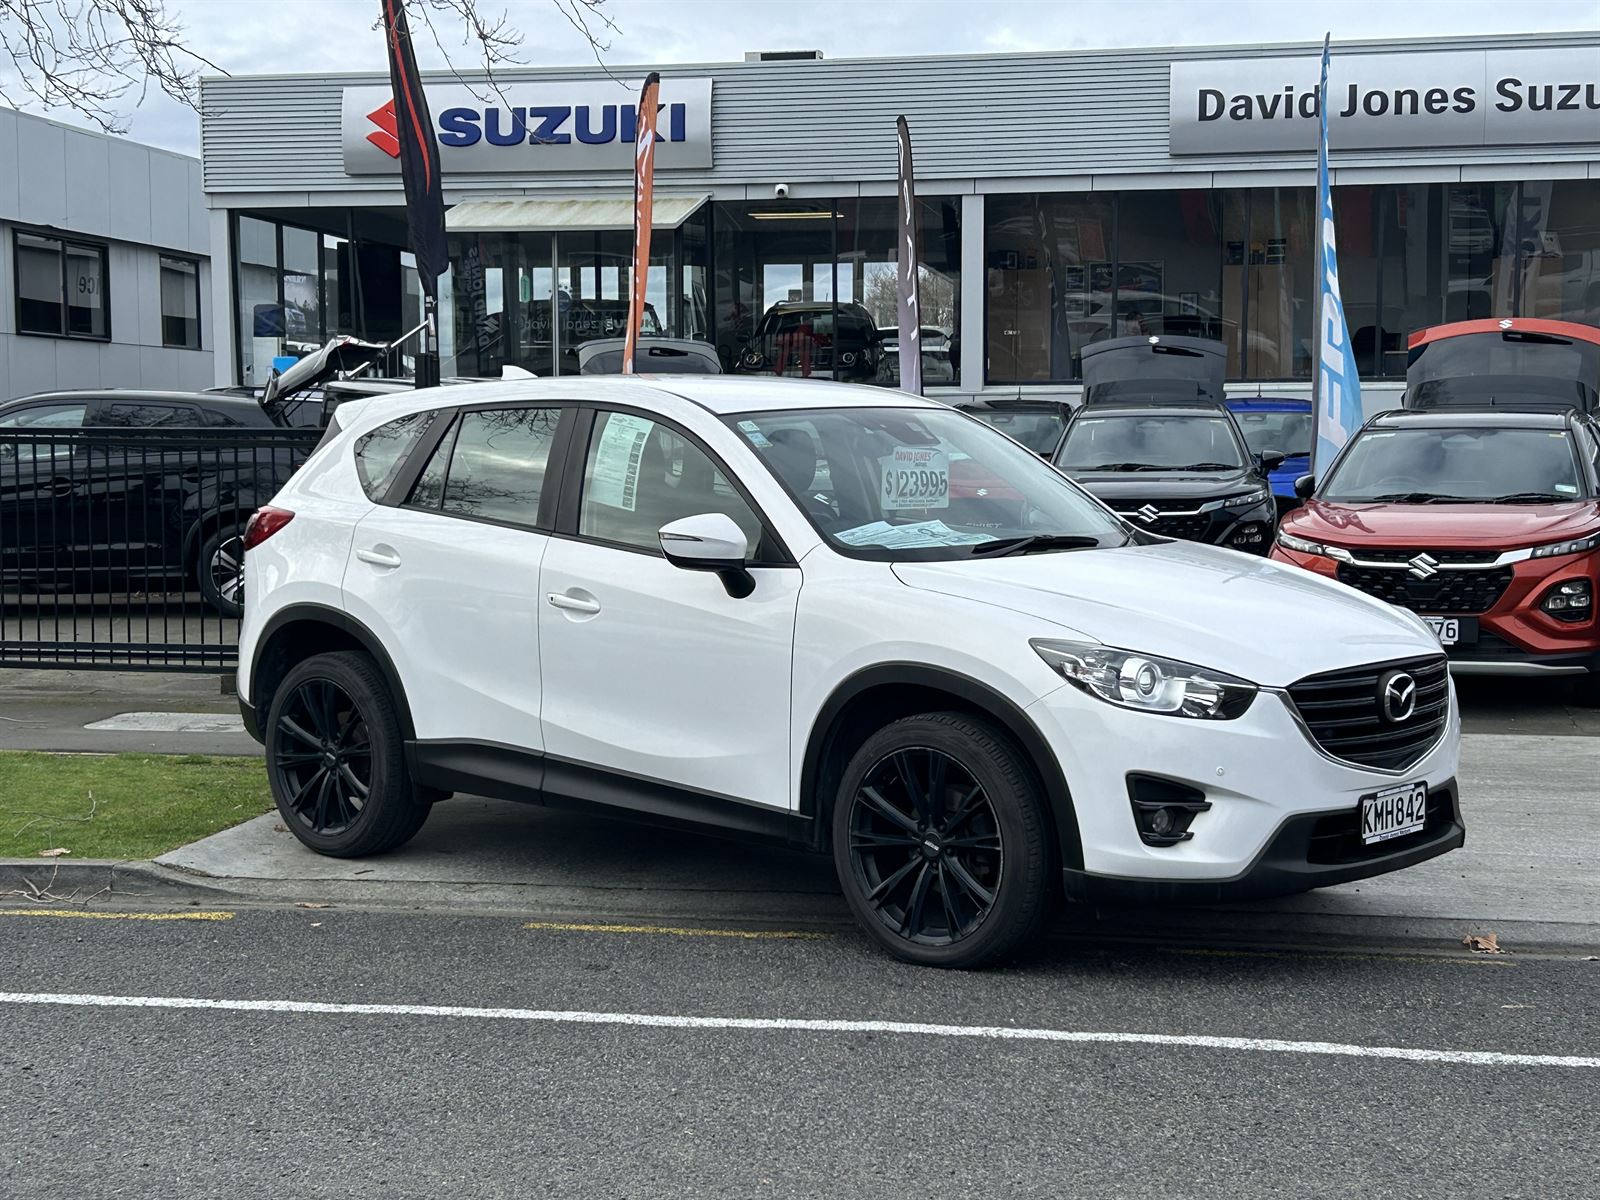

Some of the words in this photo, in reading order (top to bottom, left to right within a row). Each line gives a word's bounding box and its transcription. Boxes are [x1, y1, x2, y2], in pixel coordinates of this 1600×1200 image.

[1198, 85, 1320, 122] David
[1340, 84, 1476, 117] Jones
[438, 103, 686, 147] SUZUKI
[1427, 622, 1457, 638] 76
[1362, 791, 1424, 835] KMH842
